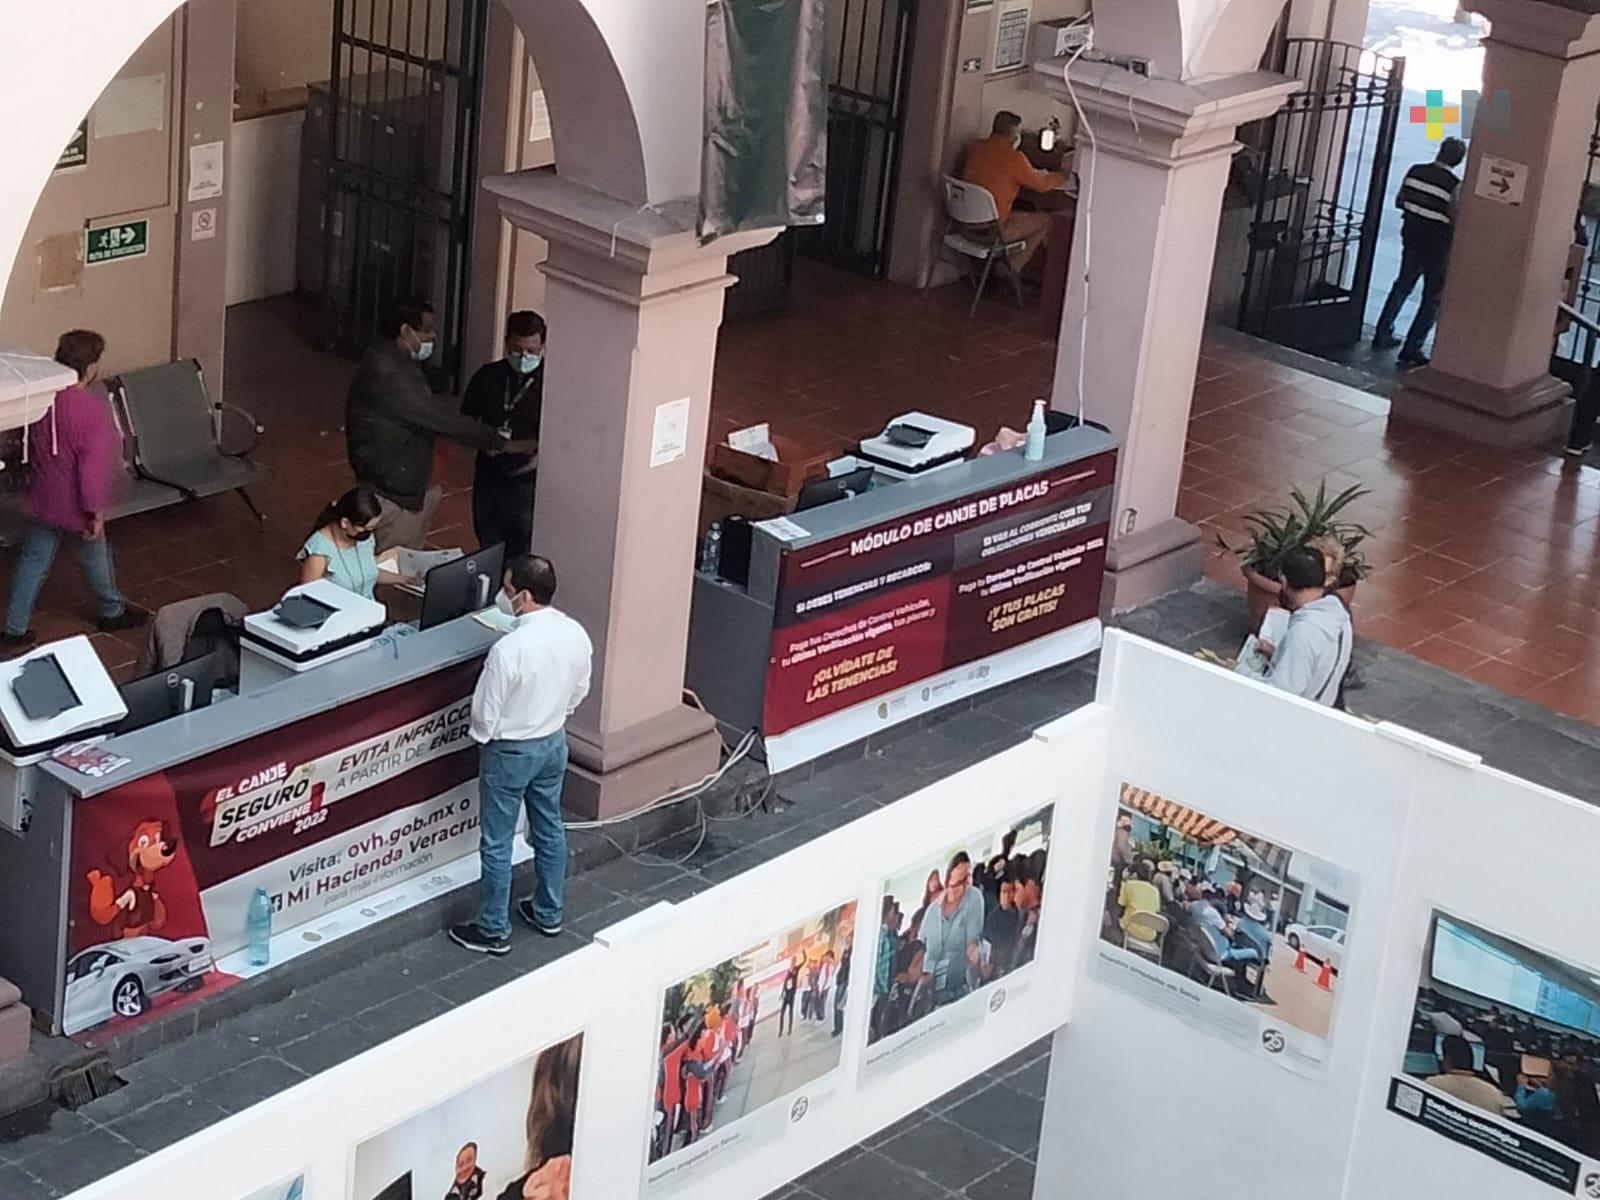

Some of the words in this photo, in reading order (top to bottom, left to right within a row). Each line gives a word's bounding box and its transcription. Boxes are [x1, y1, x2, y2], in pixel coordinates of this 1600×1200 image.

[851, 524, 911, 556] MÓDULO
[913, 518, 933, 536] DE
[935, 504, 977, 529] CANJE
[979, 496, 998, 515] DE
[1000, 480, 1049, 508] PLACAS
[992, 615, 1015, 632] SON
[1017, 599, 1058, 623] GRATIS!
[1002, 598, 1022, 614] TUS
[1023, 583, 1065, 607] PLACAS
[876, 646, 895, 661] DE
[806, 684, 829, 703] LAS
[831, 660, 898, 693] TENENCIAS!
[335, 777, 346, 791] A
[351, 756, 400, 785] PARTIR
[405, 743, 426, 763] DE
[429, 724, 470, 751] ENER
[337, 740, 390, 774] EVITA
[395, 703, 471, 749] INFRACC
[215, 787, 235, 803] EL
[238, 762, 287, 794] CANJE
[219, 779, 309, 829] SEGURO
[236, 801, 312, 843] CONVIENE
[289, 851, 343, 883] Visita:
[347, 806, 455, 858] ovh.gob.mx
[460, 798, 470, 812] o
[293, 808, 328, 835] 2022
[287, 882, 310, 908] Mi
[316, 848, 404, 896] Hacienda
[409, 816, 480, 854] Veracru
